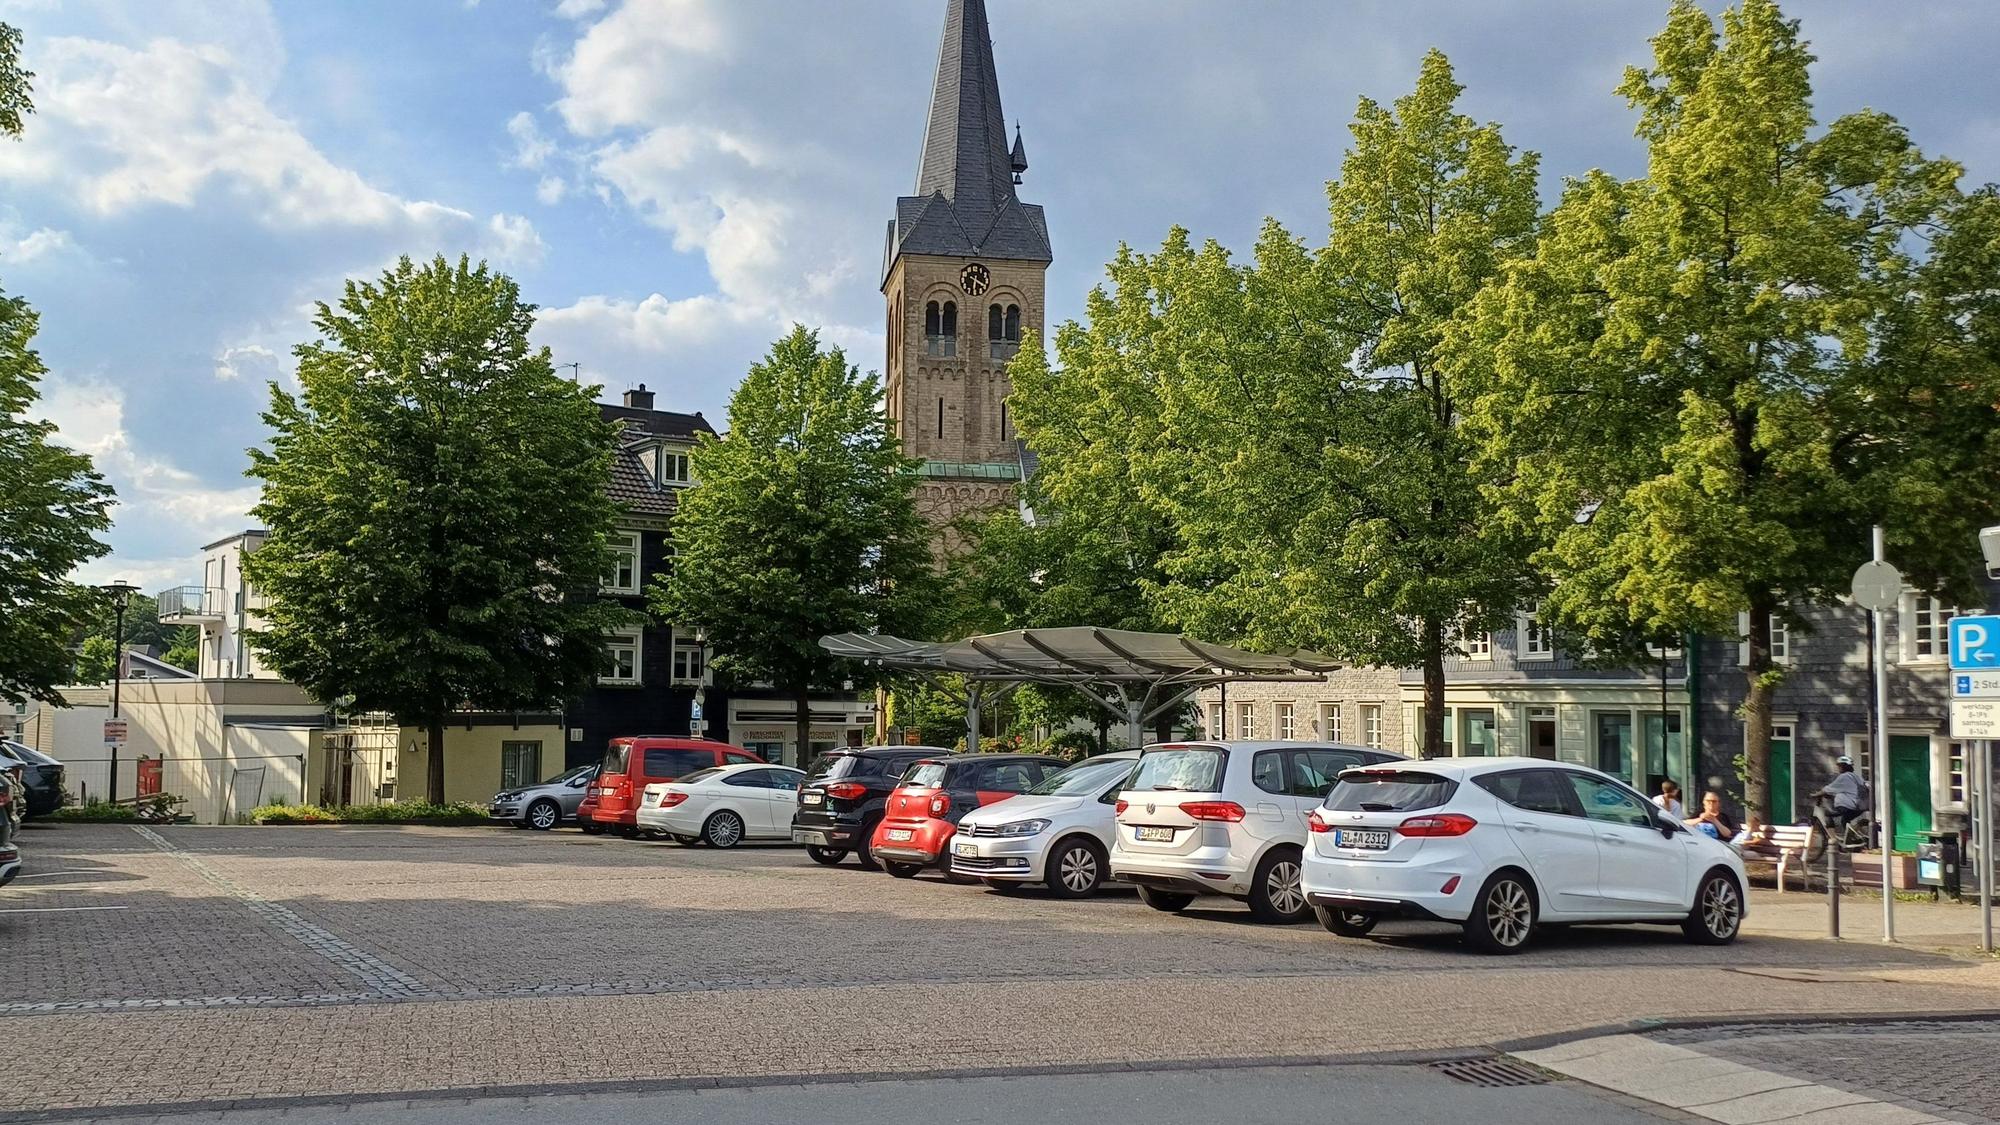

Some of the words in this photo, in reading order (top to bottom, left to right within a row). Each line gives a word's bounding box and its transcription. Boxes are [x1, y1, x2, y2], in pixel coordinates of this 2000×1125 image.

[1958, 624, 1987, 662] P
[1974, 681, 1980, 689] 2
[1342, 831, 1352, 843] GL
[1358, 832, 1363, 843] A
[1365, 833, 1387, 845] 2312
